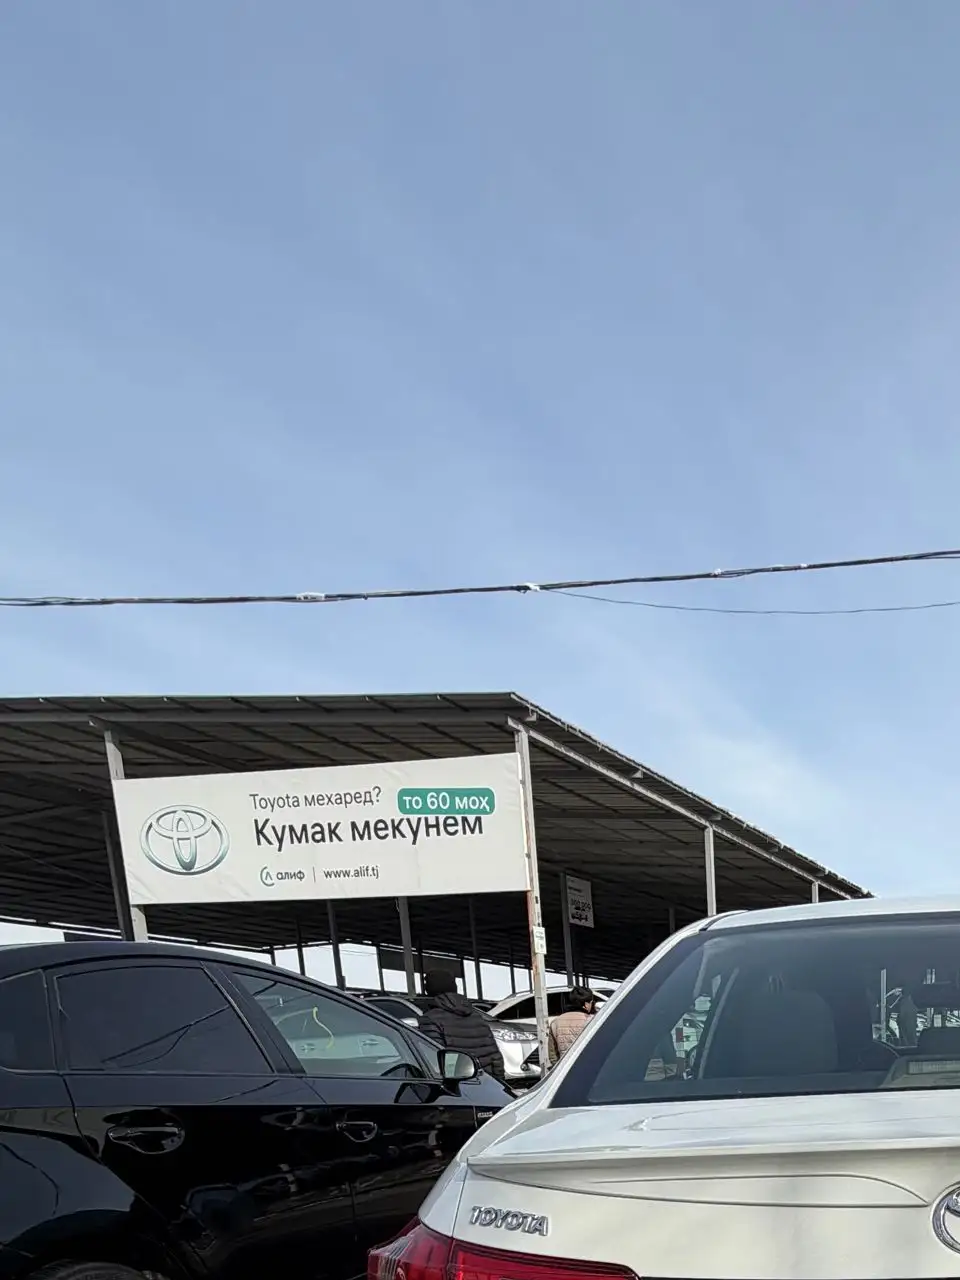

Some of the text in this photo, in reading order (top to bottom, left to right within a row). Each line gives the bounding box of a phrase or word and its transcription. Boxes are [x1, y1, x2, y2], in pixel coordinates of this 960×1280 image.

[249, 785, 382, 813] Toyota мехаред?
[402, 796, 423, 810] то
[426, 792, 450, 810] 60
[253, 815, 484, 852] Кумак мекунем
[276, 865, 380, 882] алиф www.alif.tj
[469, 1206, 549, 1236] TOYOTA
